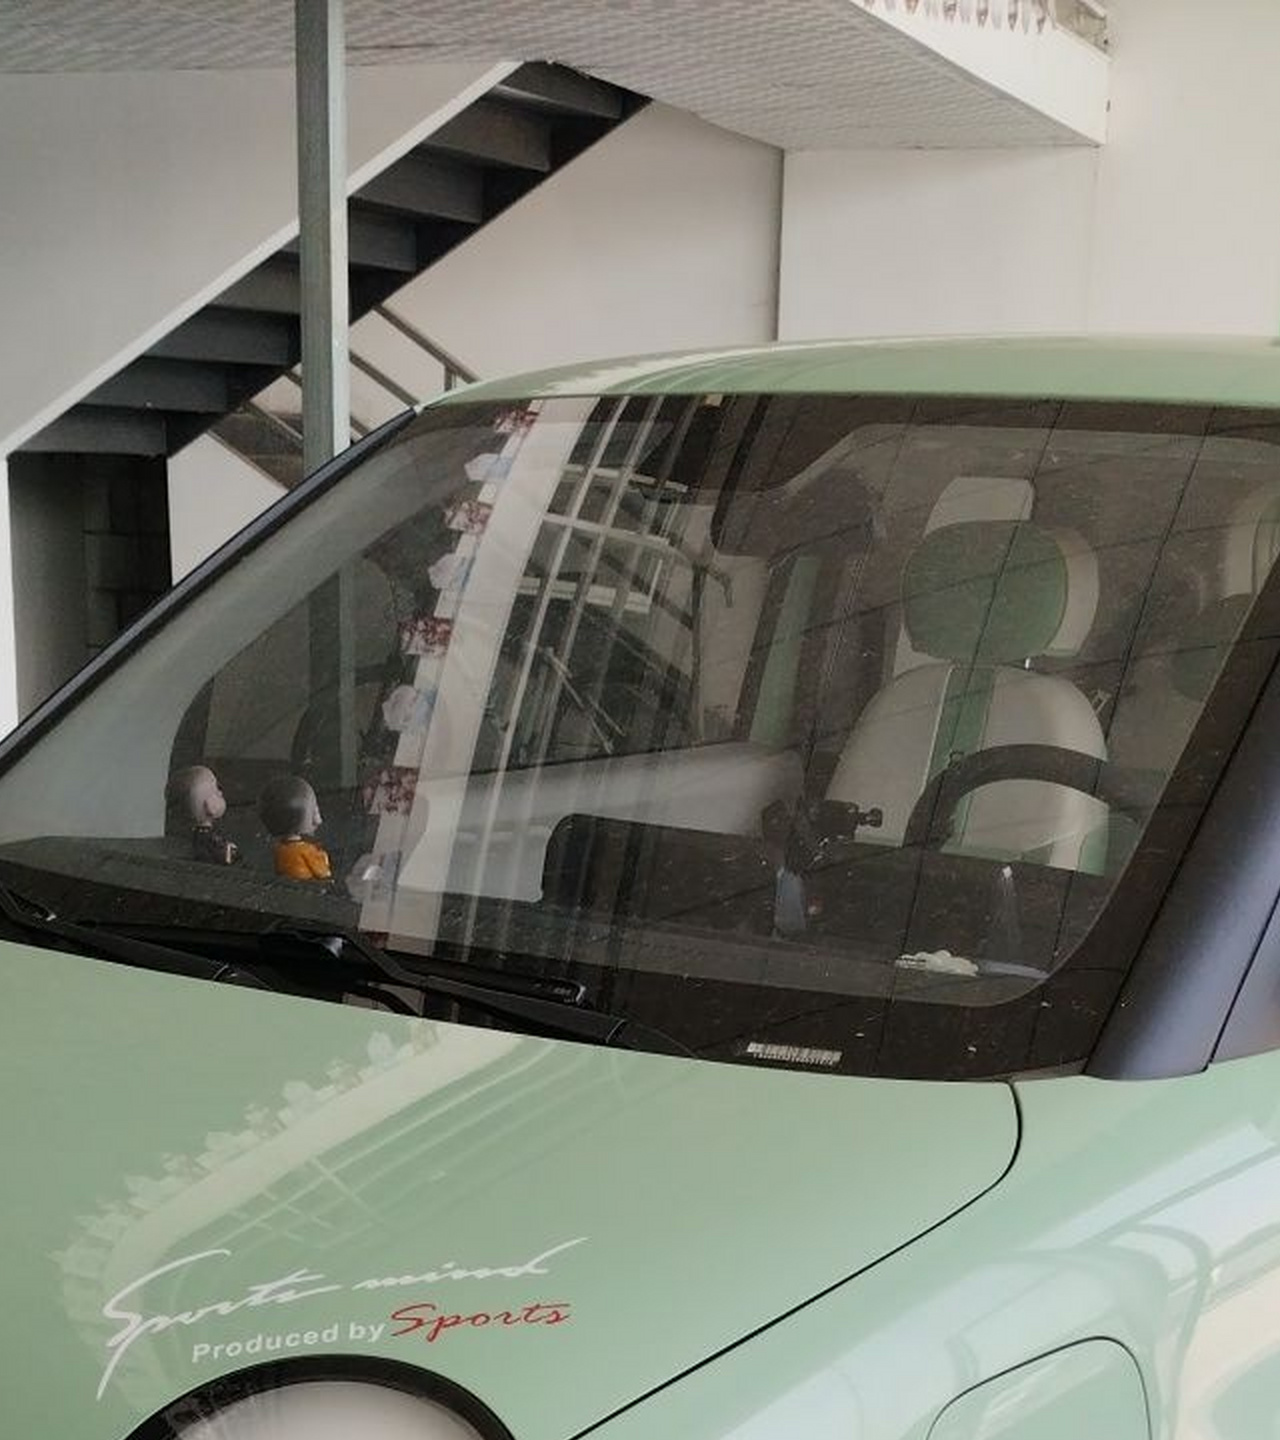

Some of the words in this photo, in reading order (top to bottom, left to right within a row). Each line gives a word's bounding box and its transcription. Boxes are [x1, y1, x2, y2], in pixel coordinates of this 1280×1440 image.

[352, 1236, 589, 1291] mind
[191, 1322, 339, 1364] Produced
[348, 1321, 387, 1344] by
[390, 1303, 571, 1343] Sports
